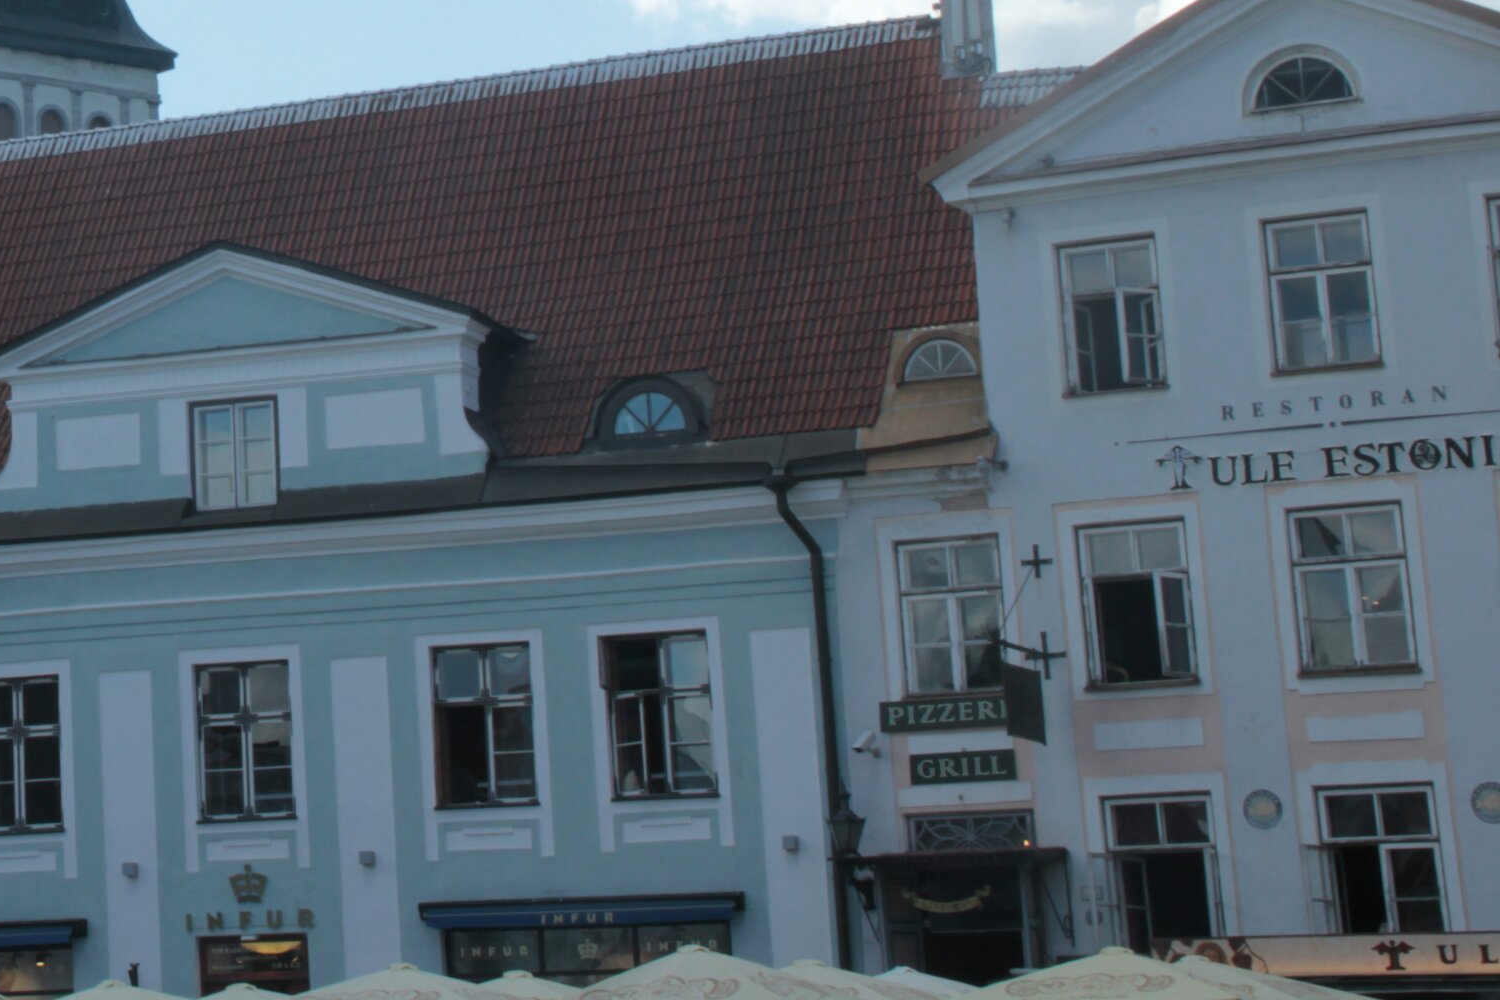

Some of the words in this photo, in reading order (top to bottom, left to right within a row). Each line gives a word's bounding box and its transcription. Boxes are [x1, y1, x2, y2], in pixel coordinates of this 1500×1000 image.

[1221, 385, 1448, 421] RESTORAN
[887, 700, 1008, 726] PIZZERI
[916, 755, 1007, 779] GRILL
[185, 908, 315, 933] INFUR
[541, 911, 615, 925] INFUR
[459, 944, 529, 958] INFUR
